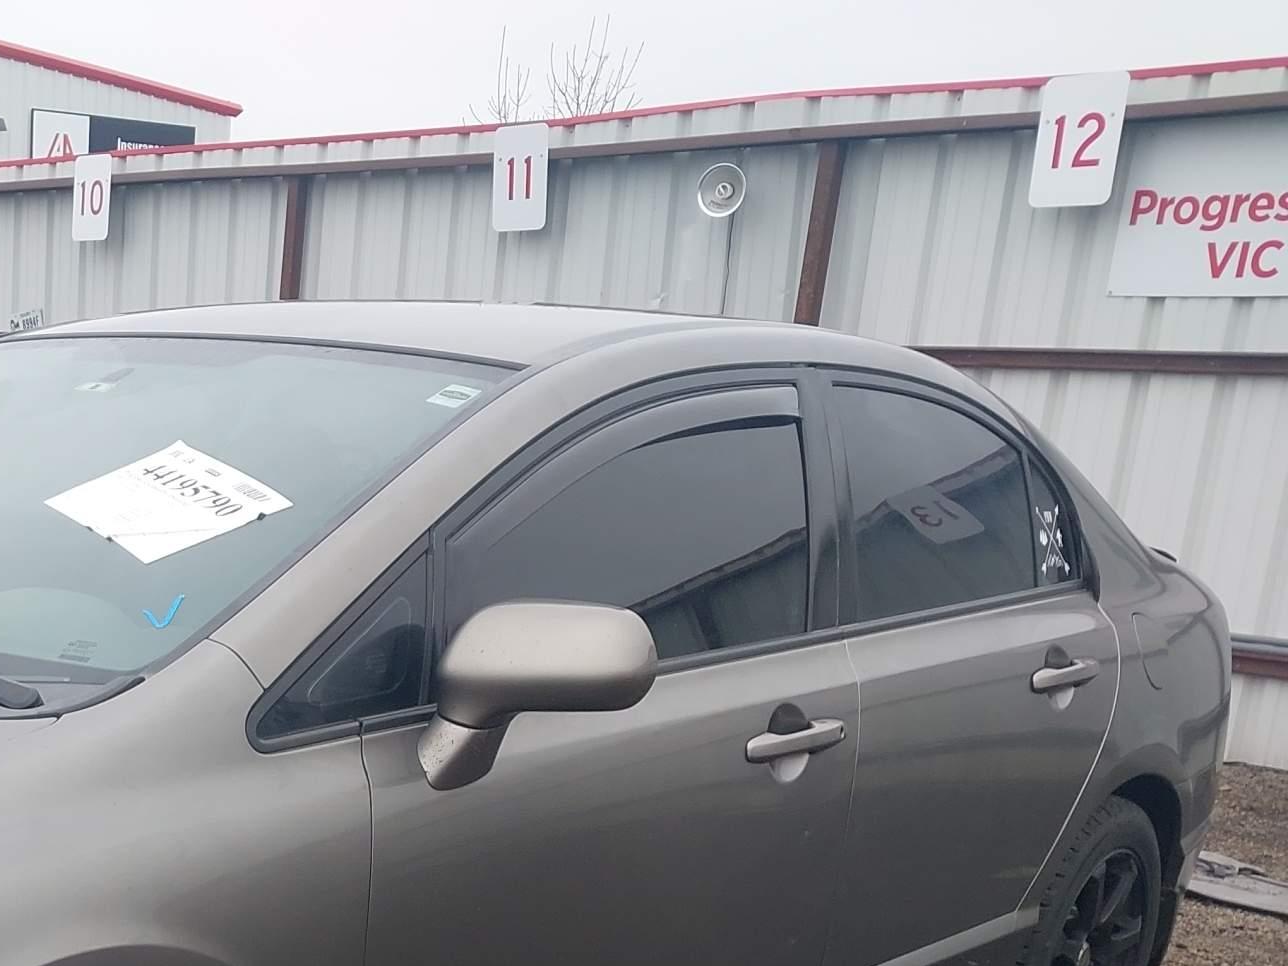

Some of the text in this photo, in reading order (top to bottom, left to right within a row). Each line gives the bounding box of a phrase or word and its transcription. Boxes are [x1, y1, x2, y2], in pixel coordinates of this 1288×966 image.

[1050, 111, 1107, 169] 12
[80, 179, 104, 217] 10
[506, 155, 532, 201] 11
[1206, 239, 1285, 279] VIC
[142, 464, 244, 517] 44195790
